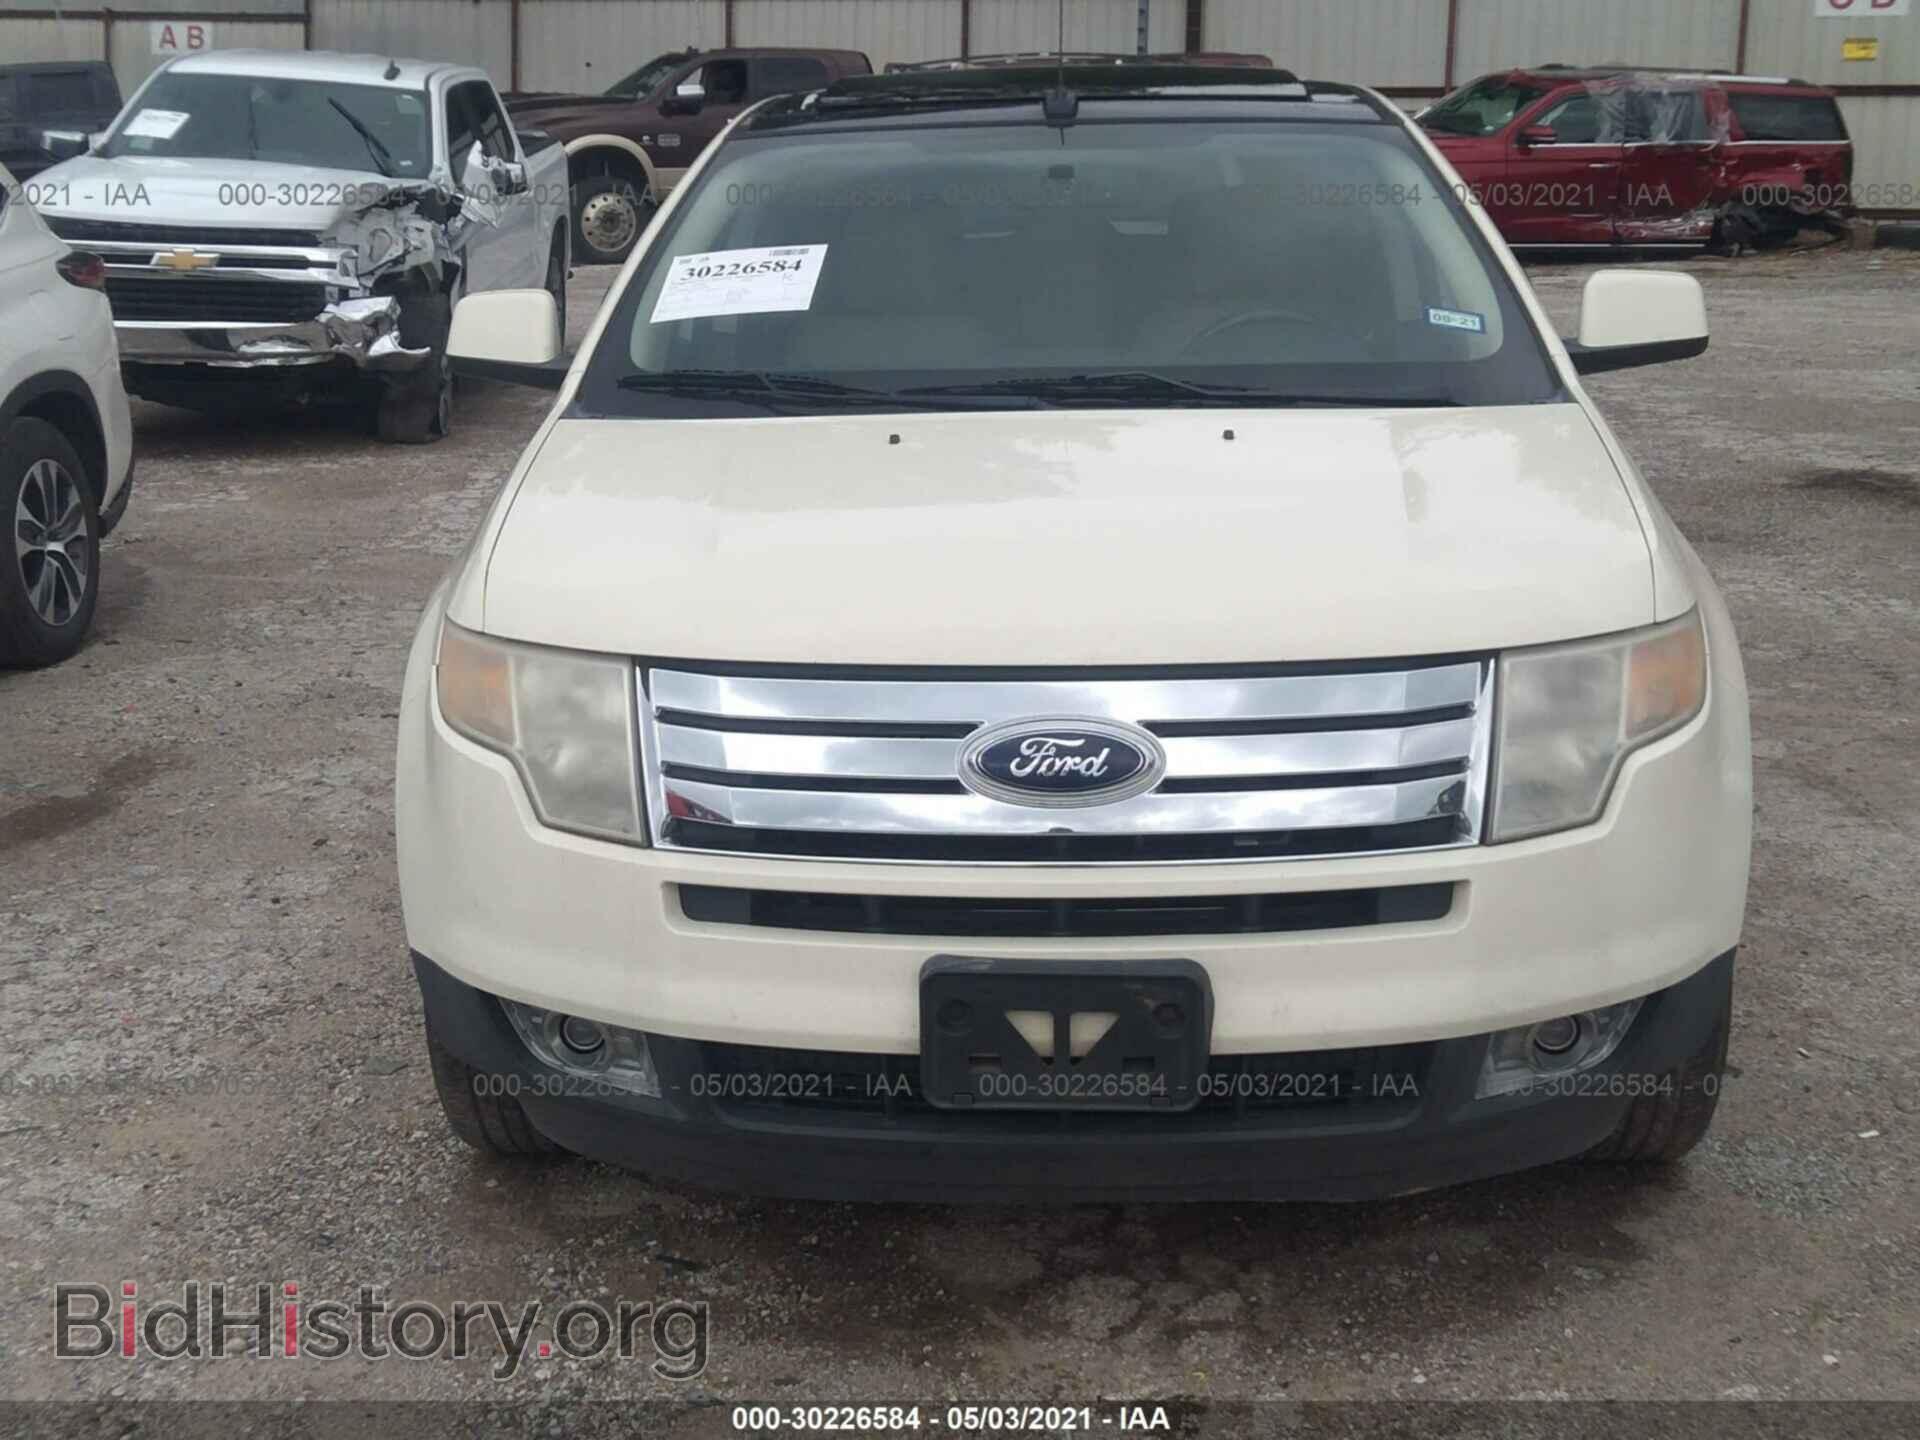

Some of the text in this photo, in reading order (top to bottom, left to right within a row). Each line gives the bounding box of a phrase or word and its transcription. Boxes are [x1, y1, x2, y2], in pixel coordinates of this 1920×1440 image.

[158, 24, 204, 50] A B
[680, 259, 803, 281] 30226584
[1010, 736, 1110, 777] Ford
